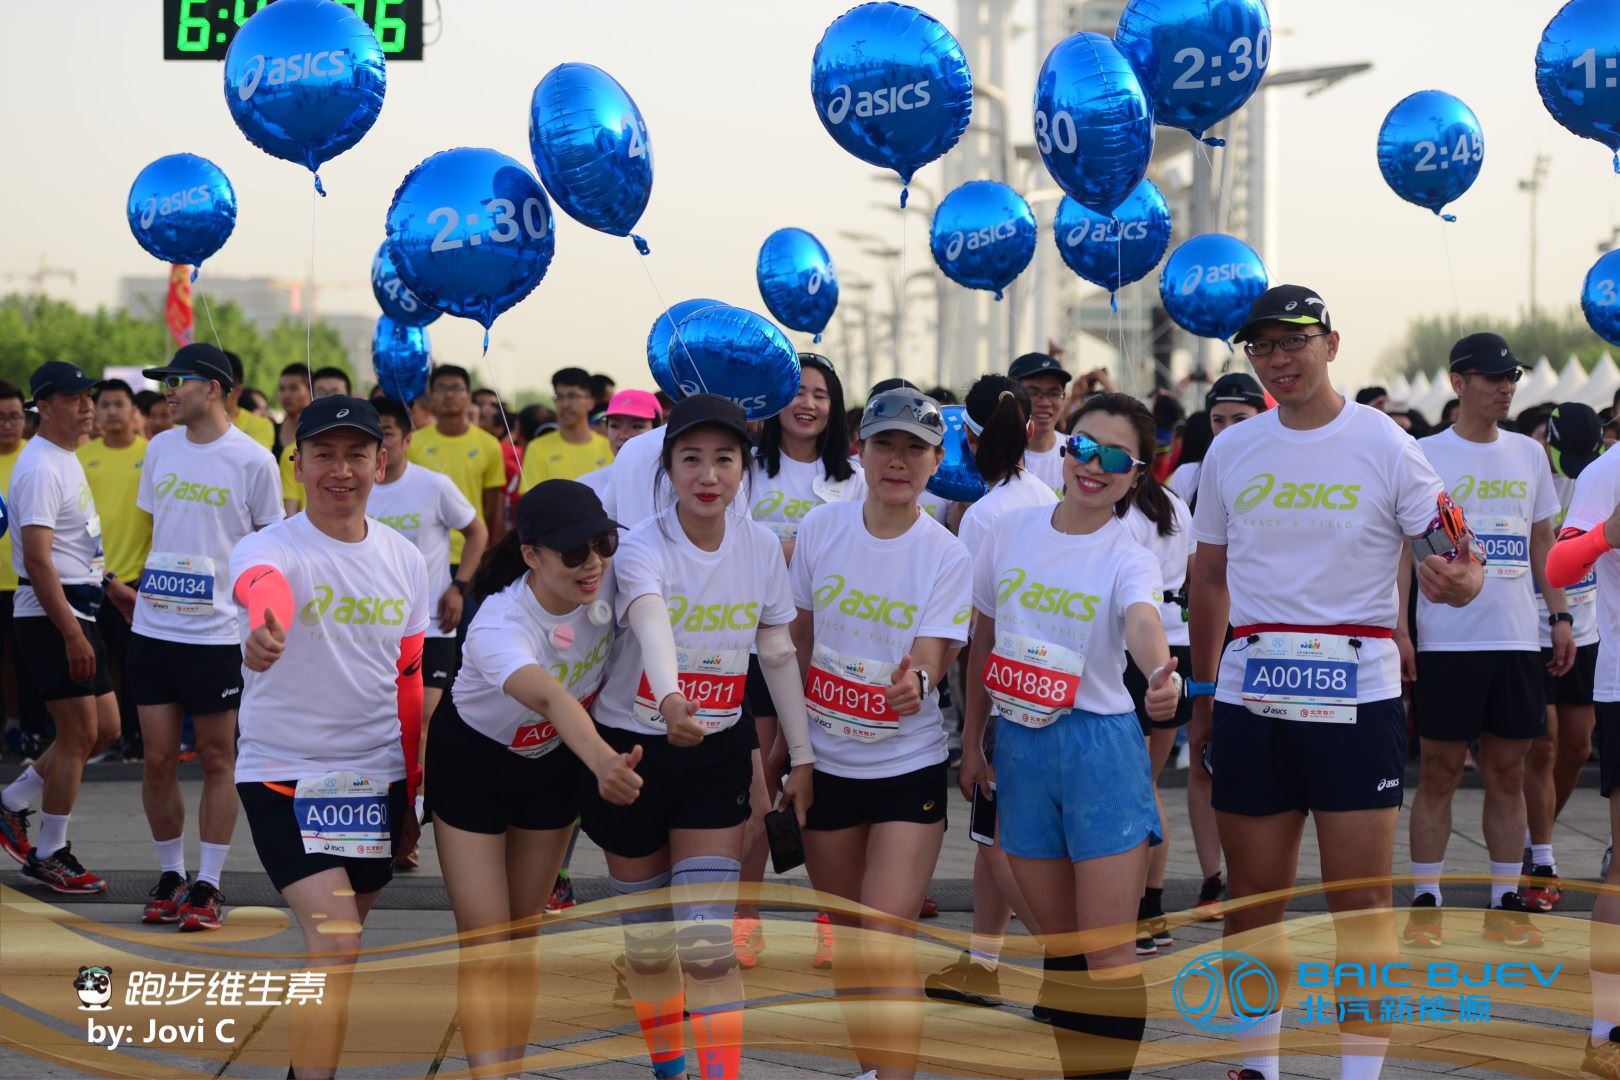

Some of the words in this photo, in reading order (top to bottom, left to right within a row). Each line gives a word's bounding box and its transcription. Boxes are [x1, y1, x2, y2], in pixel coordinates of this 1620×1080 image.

[267, 50, 346, 86] asics
[1172, 30, 1271, 90] 2:30
[855, 81, 931, 118] asics
[1413, 131, 1485, 172] 2:45
[159, 184, 211, 216] asics
[427, 198, 547, 252] 2:30
[967, 219, 1018, 250] asics
[174, 480, 230, 508] asics
[1272, 481, 1362, 511] asics
[1476, 475, 1527, 500] asics
[145, 573, 207, 596] A00134
[333, 597, 406, 627] asics
[685, 600, 760, 632] asics
[839, 588, 920, 632] asics
[1019, 580, 1102, 623] asics
[985, 662, 1069, 703] A01888
[1252, 665, 1347, 691] A00158
[810, 675, 888, 716] A01913
[306, 803, 388, 826] A00160
